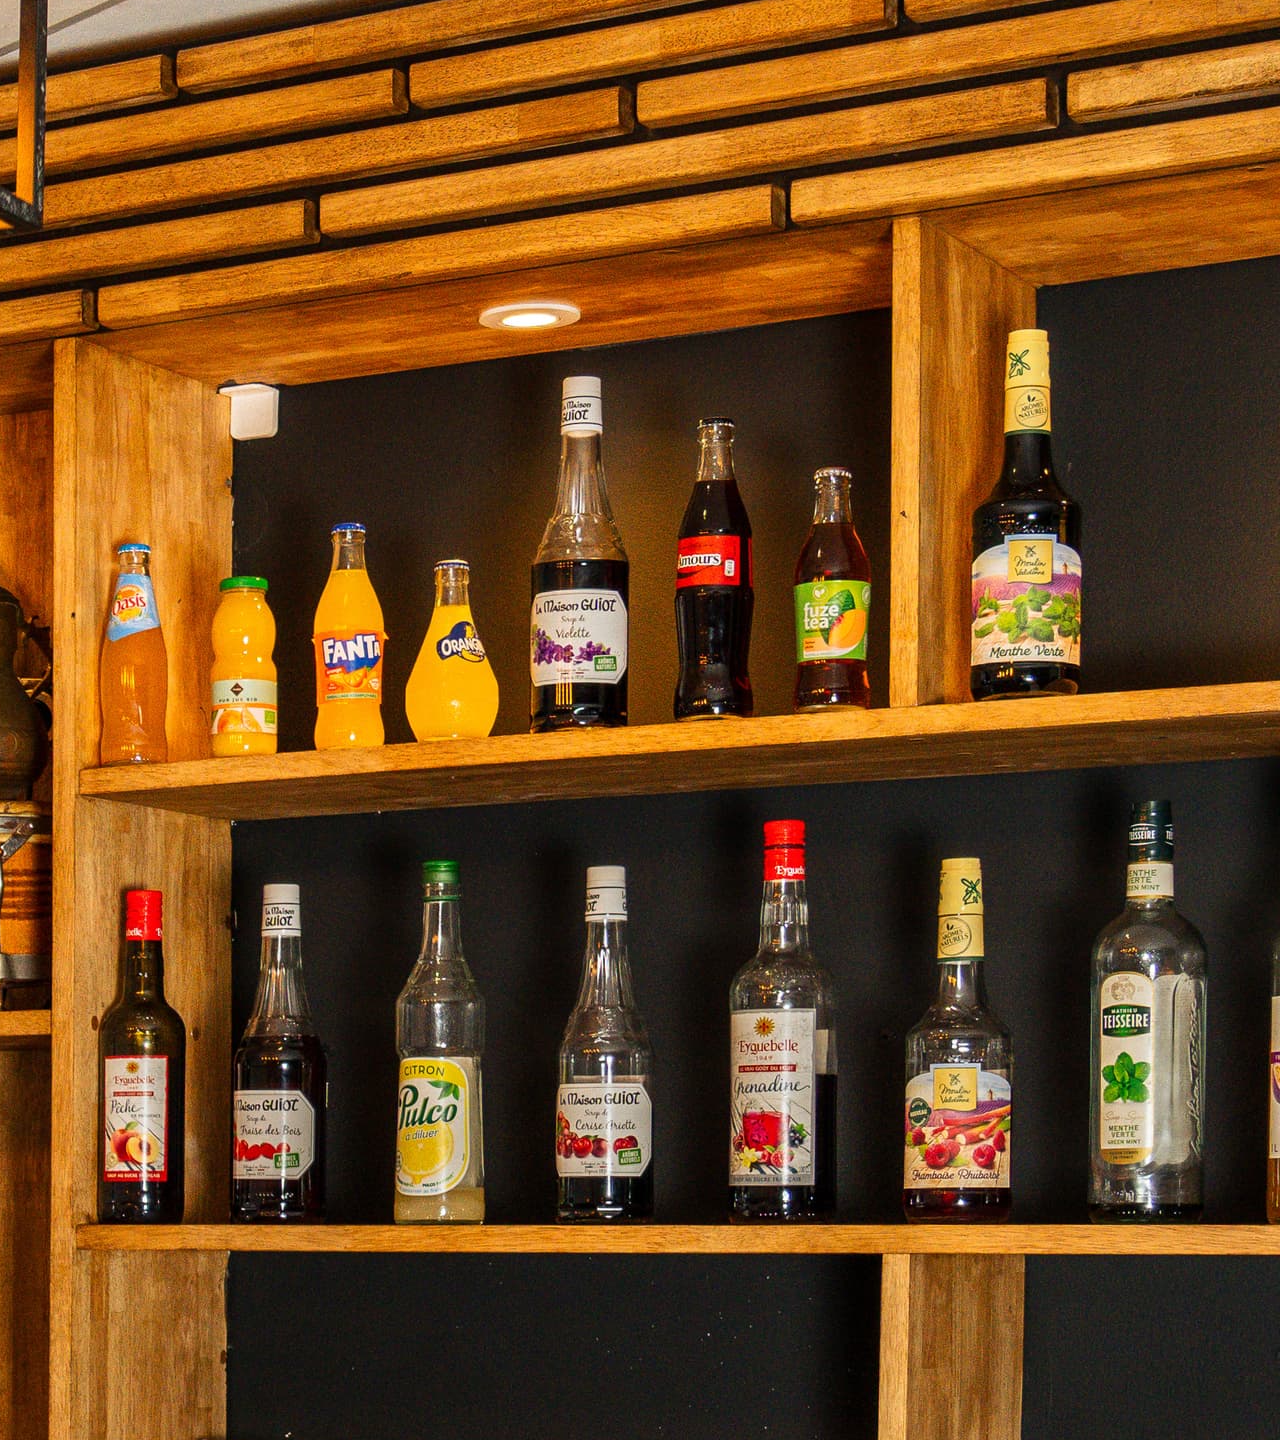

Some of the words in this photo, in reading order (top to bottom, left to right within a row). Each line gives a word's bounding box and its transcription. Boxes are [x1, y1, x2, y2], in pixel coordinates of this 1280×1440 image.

[112, 593, 146, 616] Oasis
[544, 600, 579, 612] Maison
[804, 602, 839, 618] fuze
[804, 617, 829, 630] tea
[556, 626, 591, 638] Violette
[323, 635, 381, 665] FANTA
[990, 645, 1031, 658] Menthe
[1034, 644, 1065, 658] Verte
[1129, 869, 1157, 877] ENTHE
[1104, 1014, 1149, 1029] TEISSEIRE
[738, 1040, 799, 1056] Eyguebelle
[404, 1065, 445, 1077] CITRON
[734, 1074, 810, 1098] Grenadine
[568, 1092, 602, 1105] Maison
[400, 1085, 458, 1130] Pulco
[265, 1124, 280, 1135] des
[282, 1125, 302, 1135] Bois
[576, 1120, 604, 1131] Cerise
[412, 1129, 438, 1140] diluer
[912, 1169, 954, 1181] Framboise
[958, 1169, 1000, 1180] Rhubarbe
